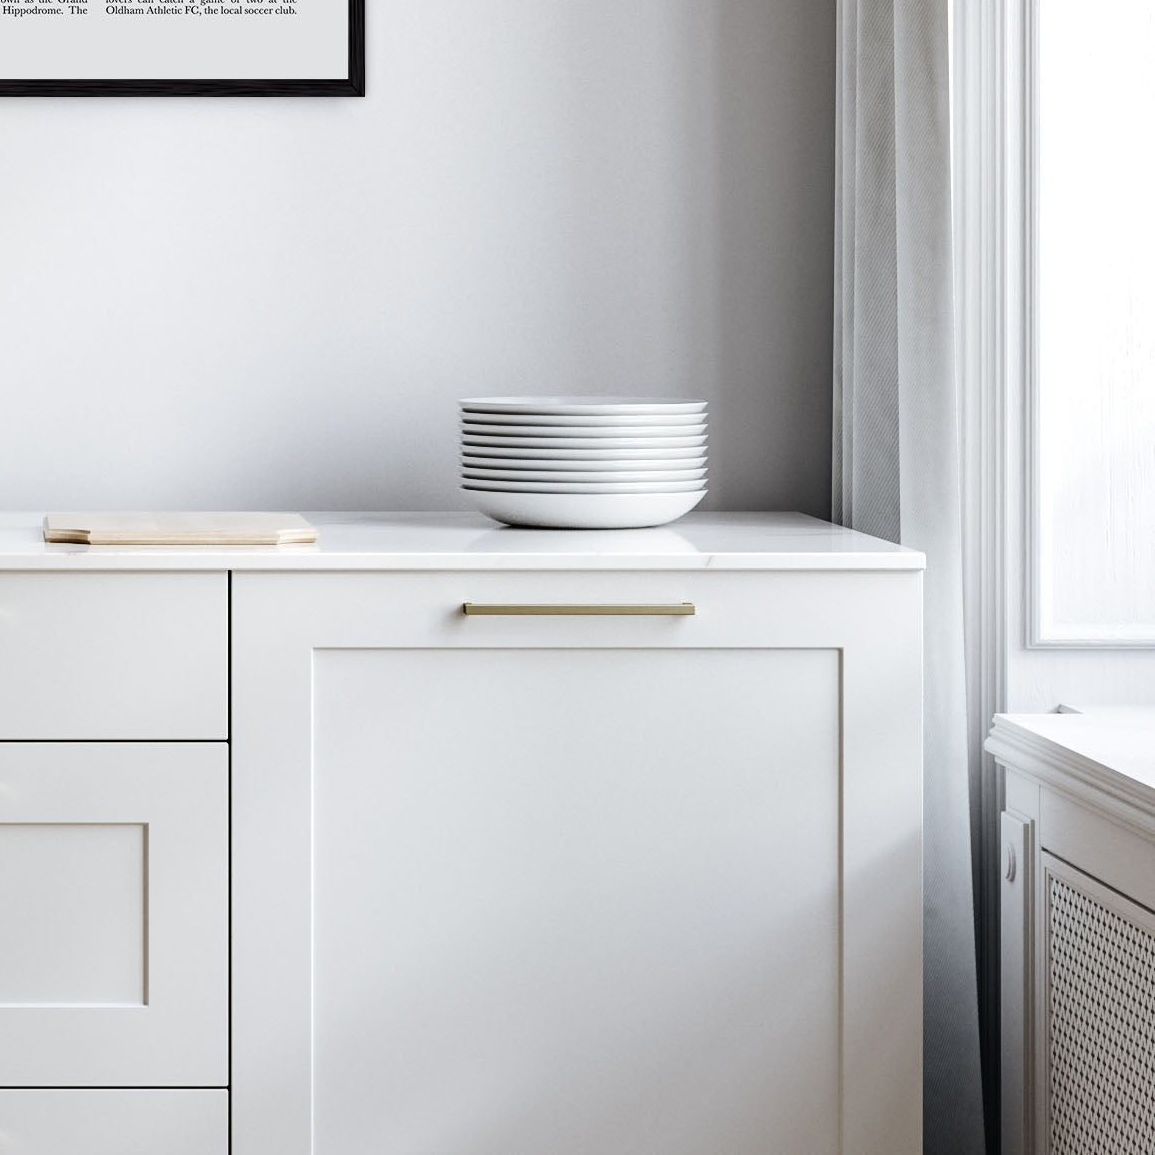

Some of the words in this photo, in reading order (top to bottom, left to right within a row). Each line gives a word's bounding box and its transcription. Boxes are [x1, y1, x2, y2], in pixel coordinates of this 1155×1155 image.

[2, 6, 64, 17] Hippodrome.
[67, 6, 88, 14] The
[105, 6, 145, 14] Oldham
[146, 6, 183, 14] Athletic
[184, 6, 202, 15] FC,
[204, 6, 219, 14] the
[220, 6, 243, 14] local
[274, 6, 297, 14] club.
